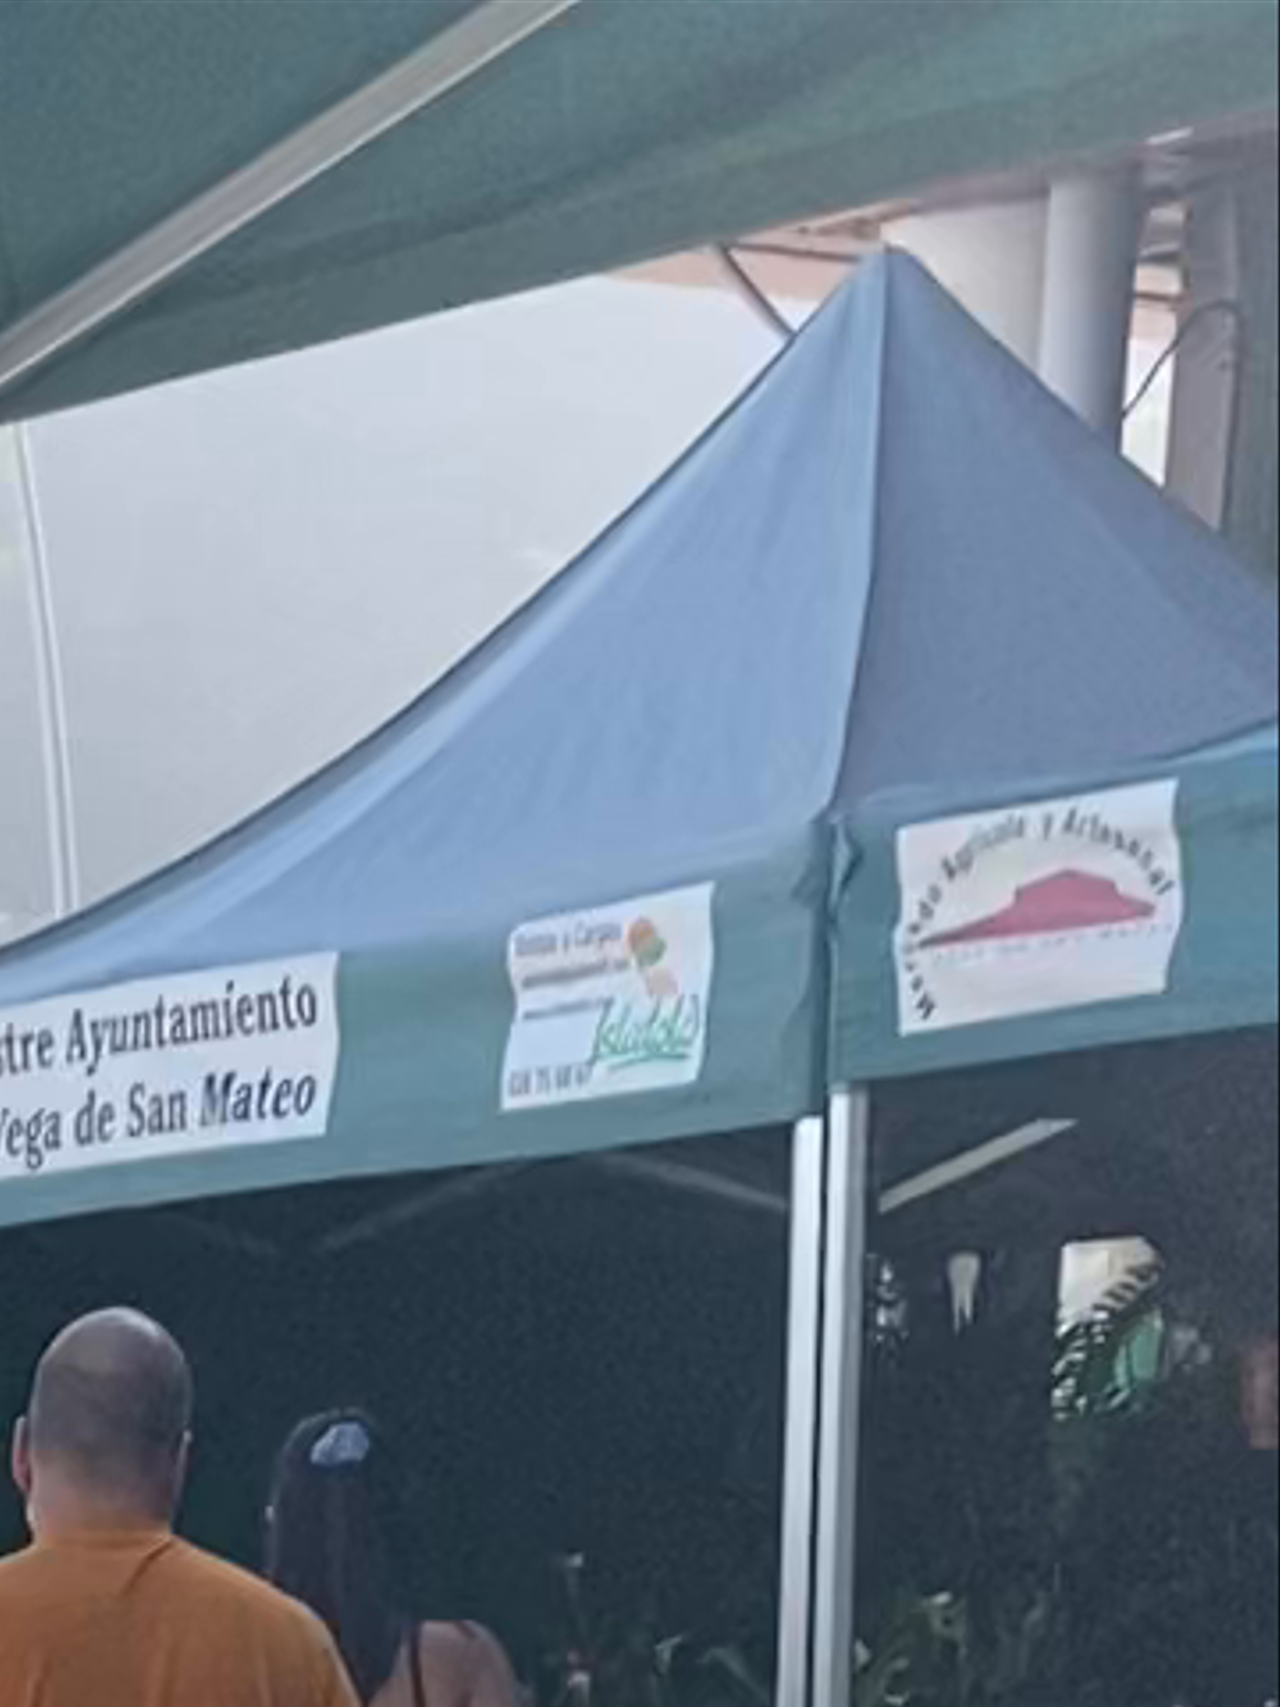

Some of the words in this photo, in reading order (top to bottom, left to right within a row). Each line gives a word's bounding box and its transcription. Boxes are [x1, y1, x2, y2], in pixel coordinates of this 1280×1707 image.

[64, 975, 318, 1076] Ayuntamiento
[73, 1088, 116, 1146] de
[126, 1081, 188, 1139] San
[199, 1066, 316, 1128] Mateo
